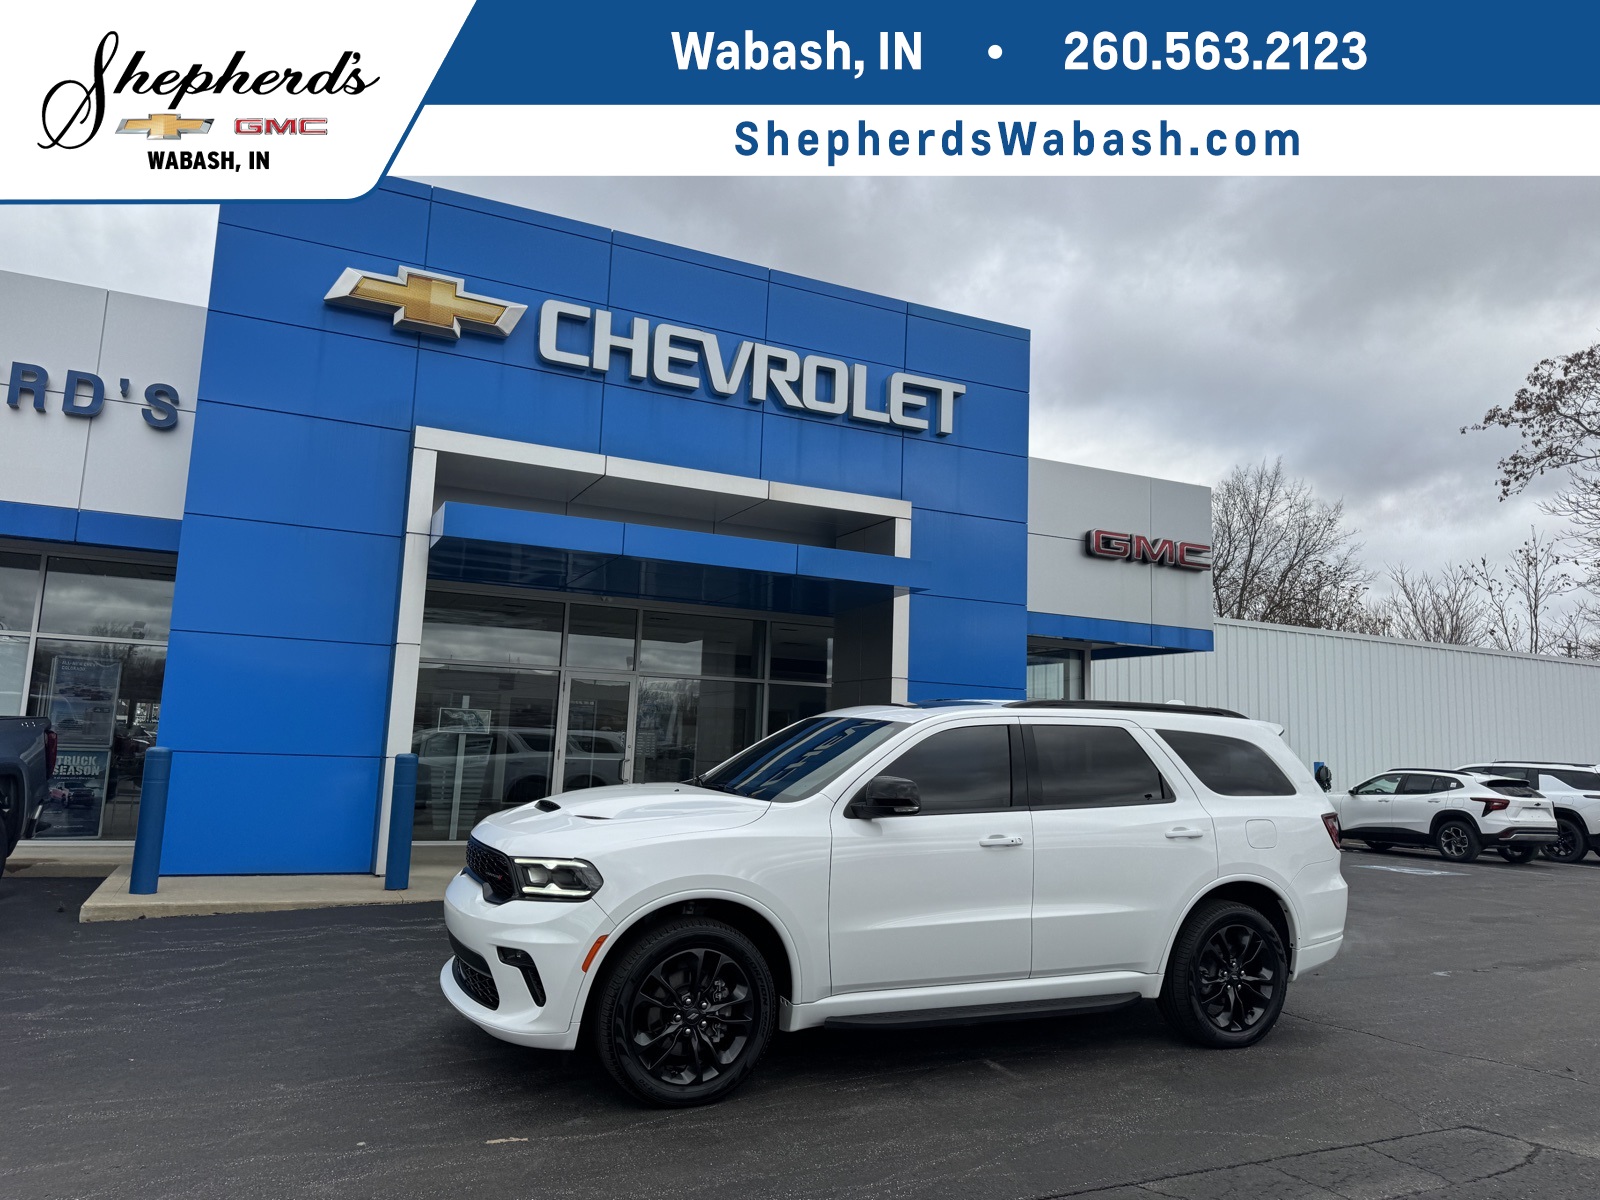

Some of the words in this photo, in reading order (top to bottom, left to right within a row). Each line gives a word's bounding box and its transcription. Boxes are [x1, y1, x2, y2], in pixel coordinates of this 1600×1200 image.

[538, 299, 967, 436] CHEVROLET
[6, 361, 180, 431] RD'S
[1085, 528, 1212, 571] GMC
[52, 765, 100, 776] SEASON
[56, 755, 97, 766] TRUCK
